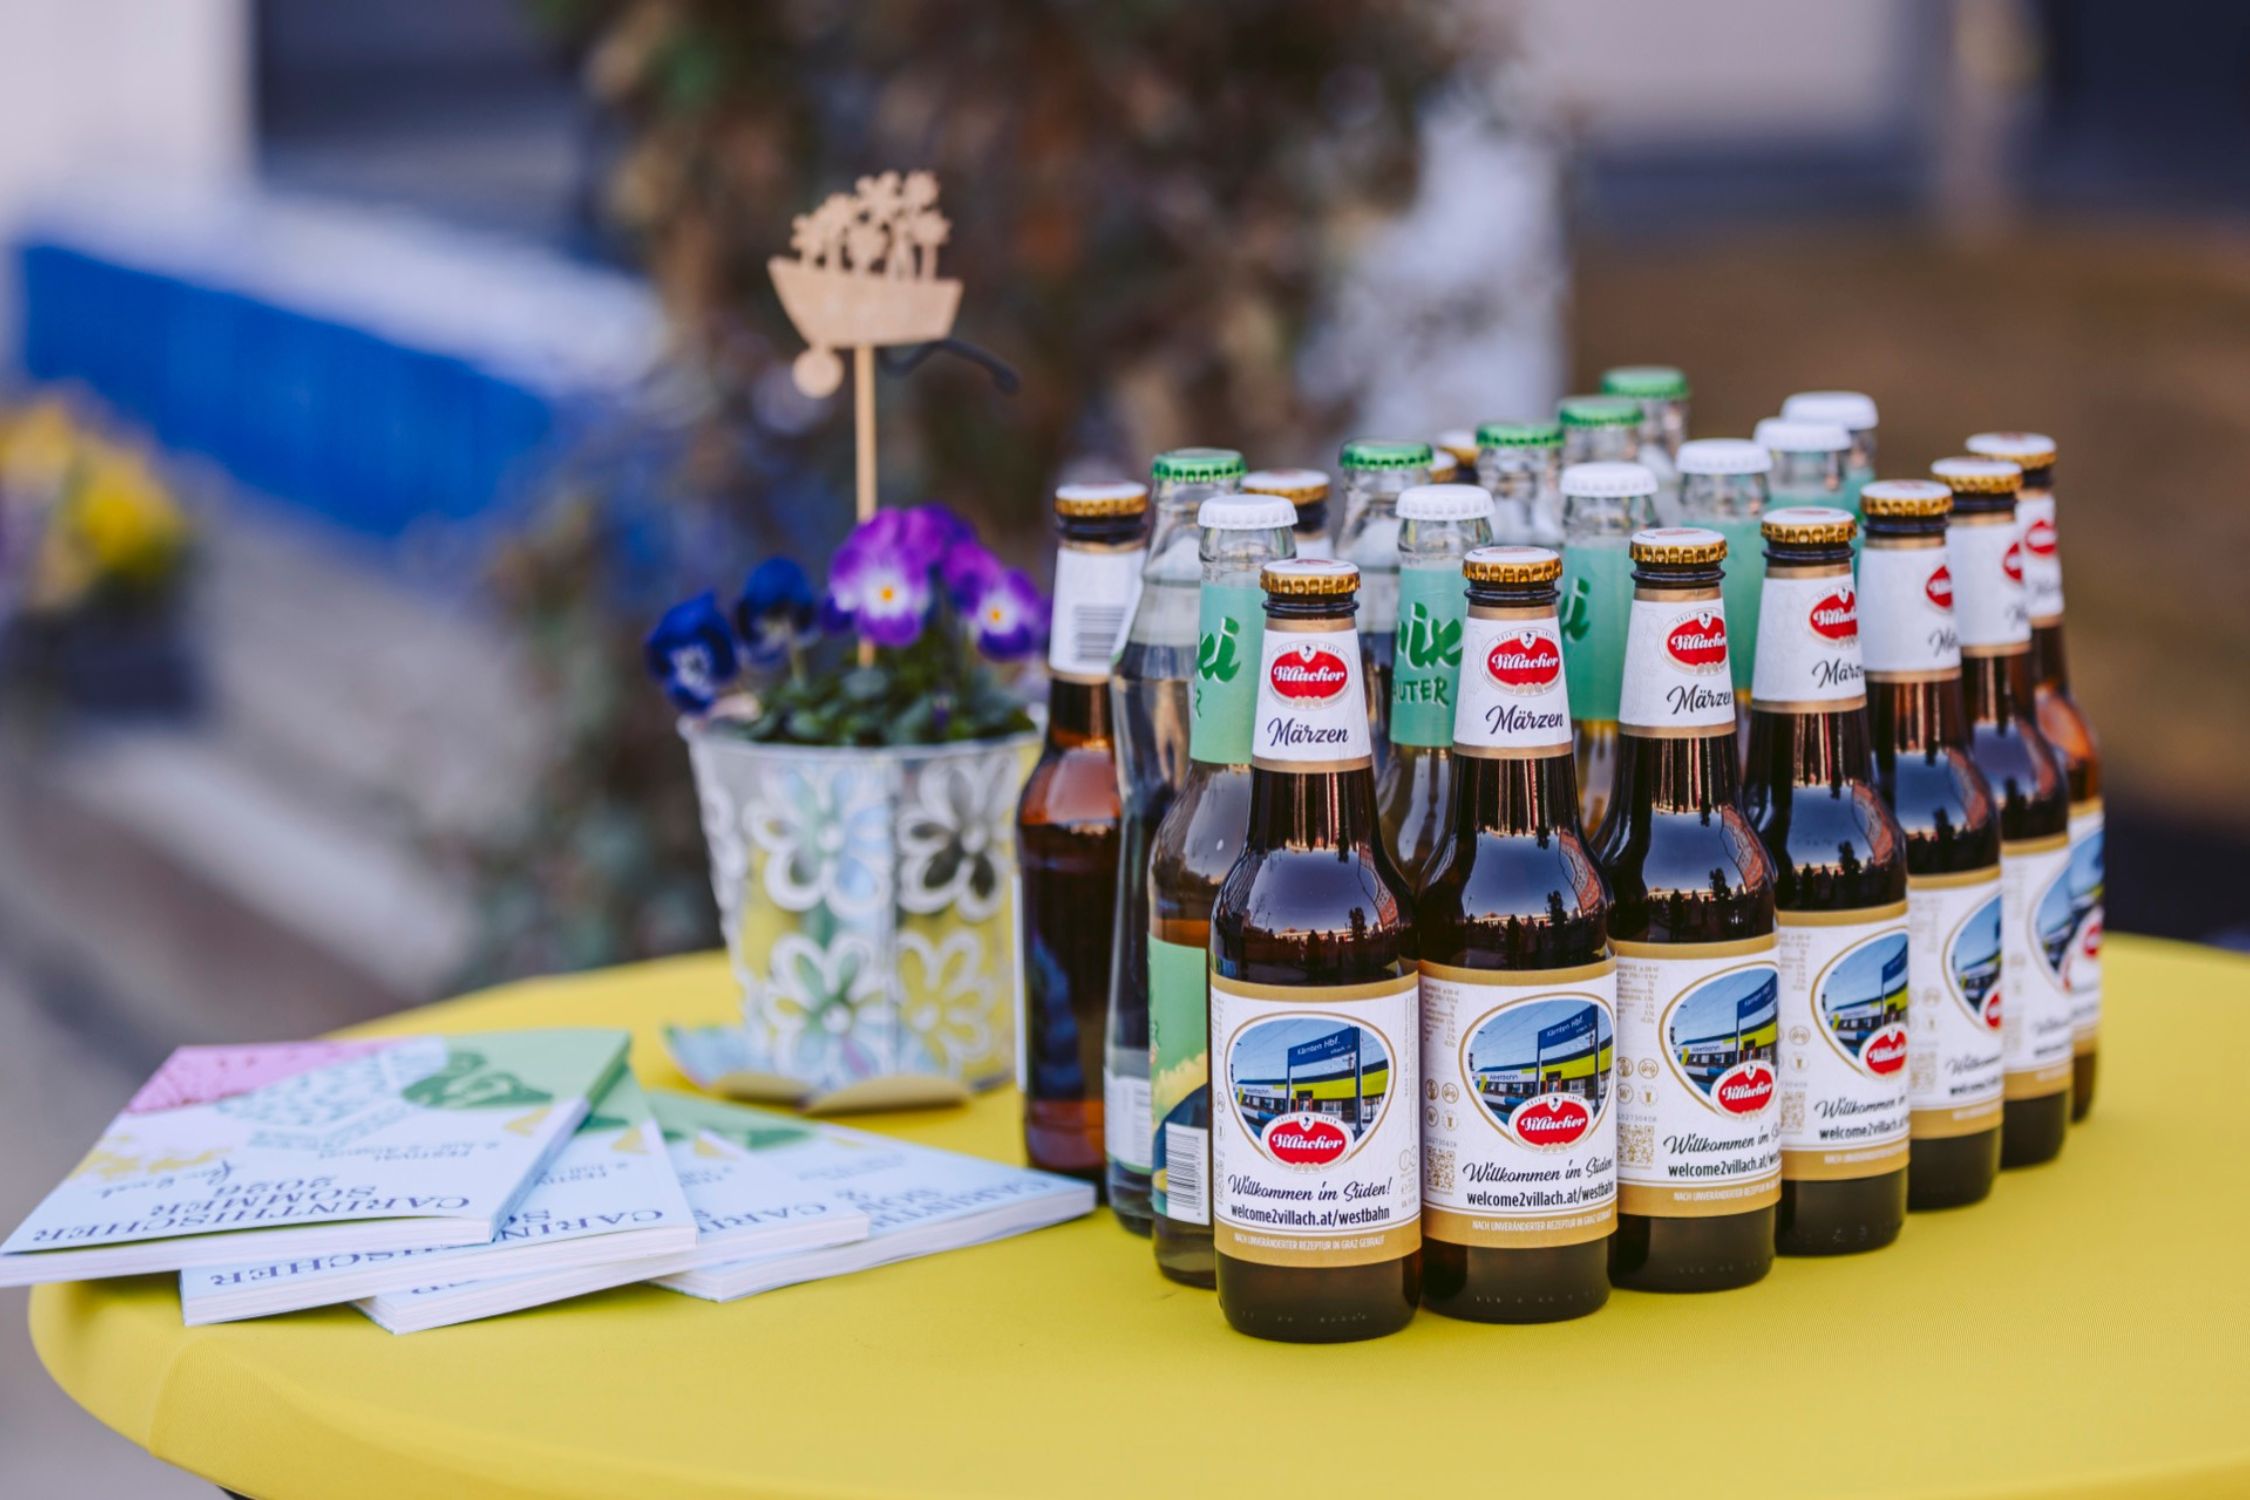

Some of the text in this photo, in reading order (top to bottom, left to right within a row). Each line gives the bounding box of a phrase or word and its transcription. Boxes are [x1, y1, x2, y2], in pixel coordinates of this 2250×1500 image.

[1273, 665, 1345, 683] Villacher
[1491, 653, 1559, 670] Villacher
[1666, 684, 1732, 715] Märze
[1267, 717, 1349, 747] Märzen
[1485, 705, 1564, 735] Märzen
[1520, 1114, 1586, 1131] Villacher
[1272, 1133, 1343, 1150] Villacher
[1663, 1133, 1755, 1155] Willkommen
[1462, 1162, 1562, 1184] Willkommen
[1565, 1159, 1582, 1180] im
[1227, 1174, 1313, 1201] Willkommen
[1317, 1181, 1338, 1200] im
[1343, 1176, 1392, 1202] Süden!
[149, 1184, 377, 1218] SOMMER
[31, 1196, 470, 1243] CARINTHISCHER
[1230, 1204, 1391, 1227] welcome2villach.at/westbahn
